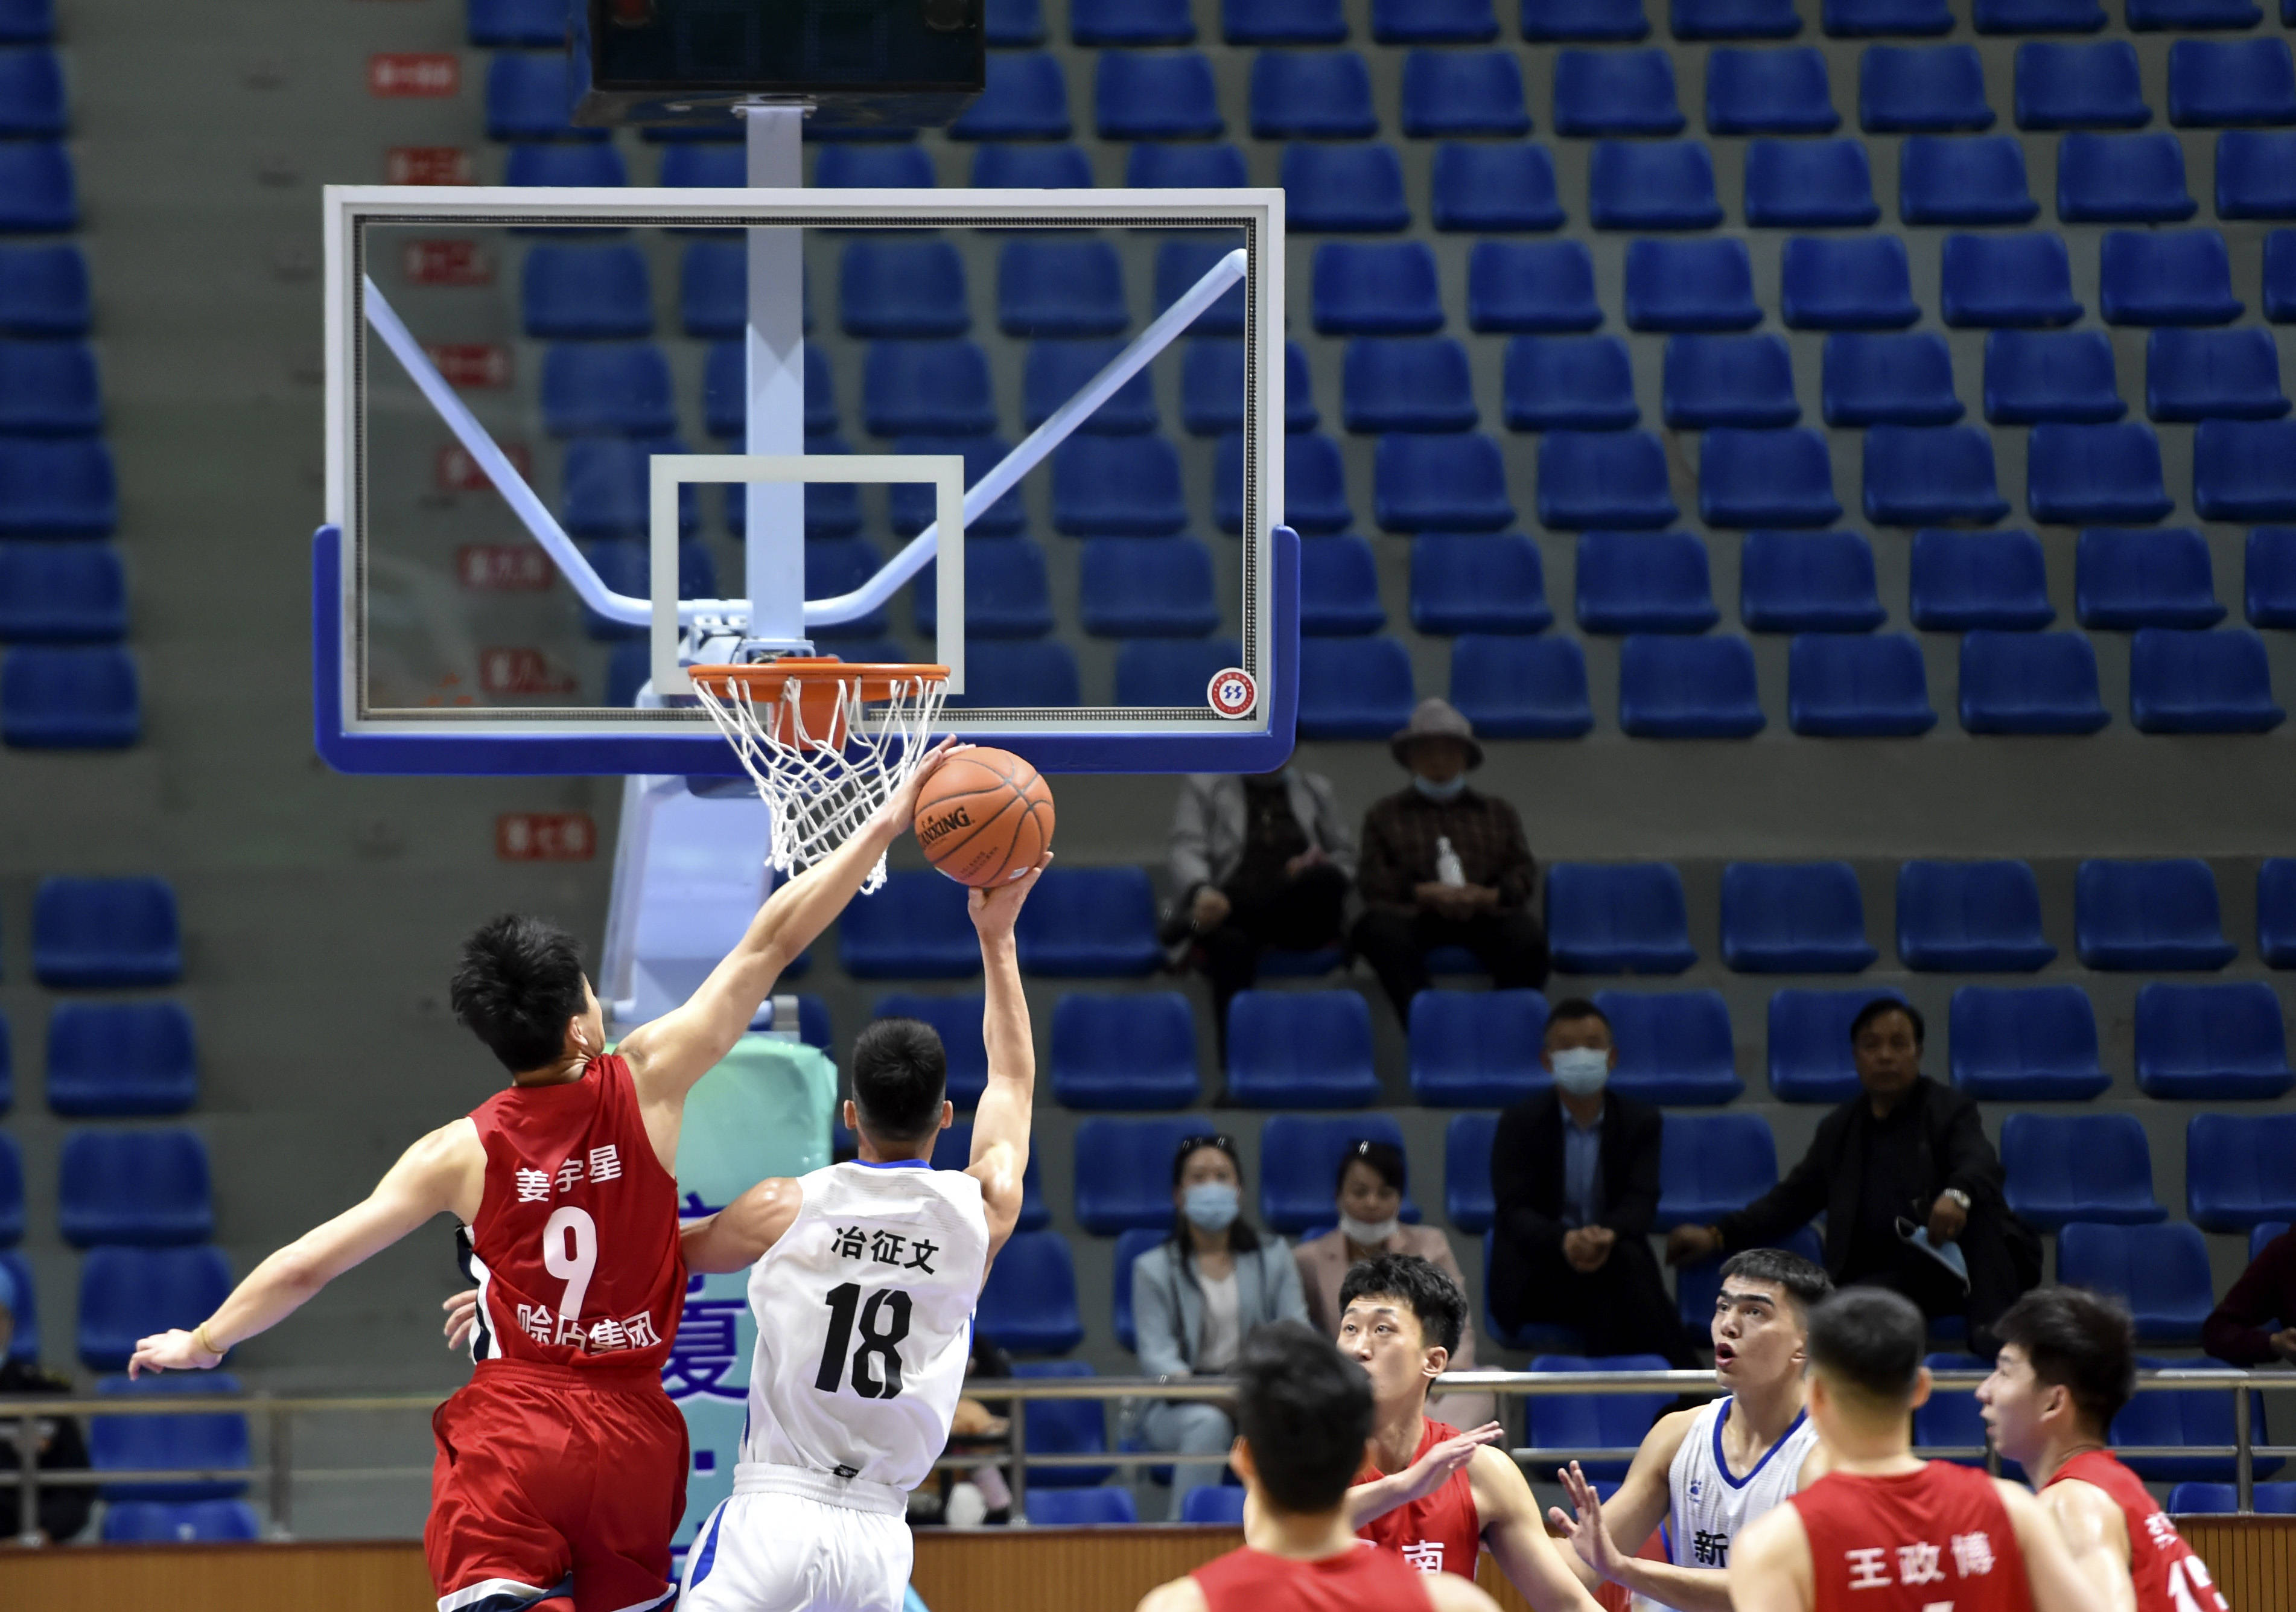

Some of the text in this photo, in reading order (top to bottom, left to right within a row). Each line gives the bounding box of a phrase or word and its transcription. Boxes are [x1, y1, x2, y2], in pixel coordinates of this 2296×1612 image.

[515, 1144, 622, 1202] 姜宇星
[543, 1206, 597, 1320] 9
[831, 1226, 939, 1275] 冶征文
[815, 1282, 912, 1400] 18
[1694, 1529, 1728, 1568] 新
